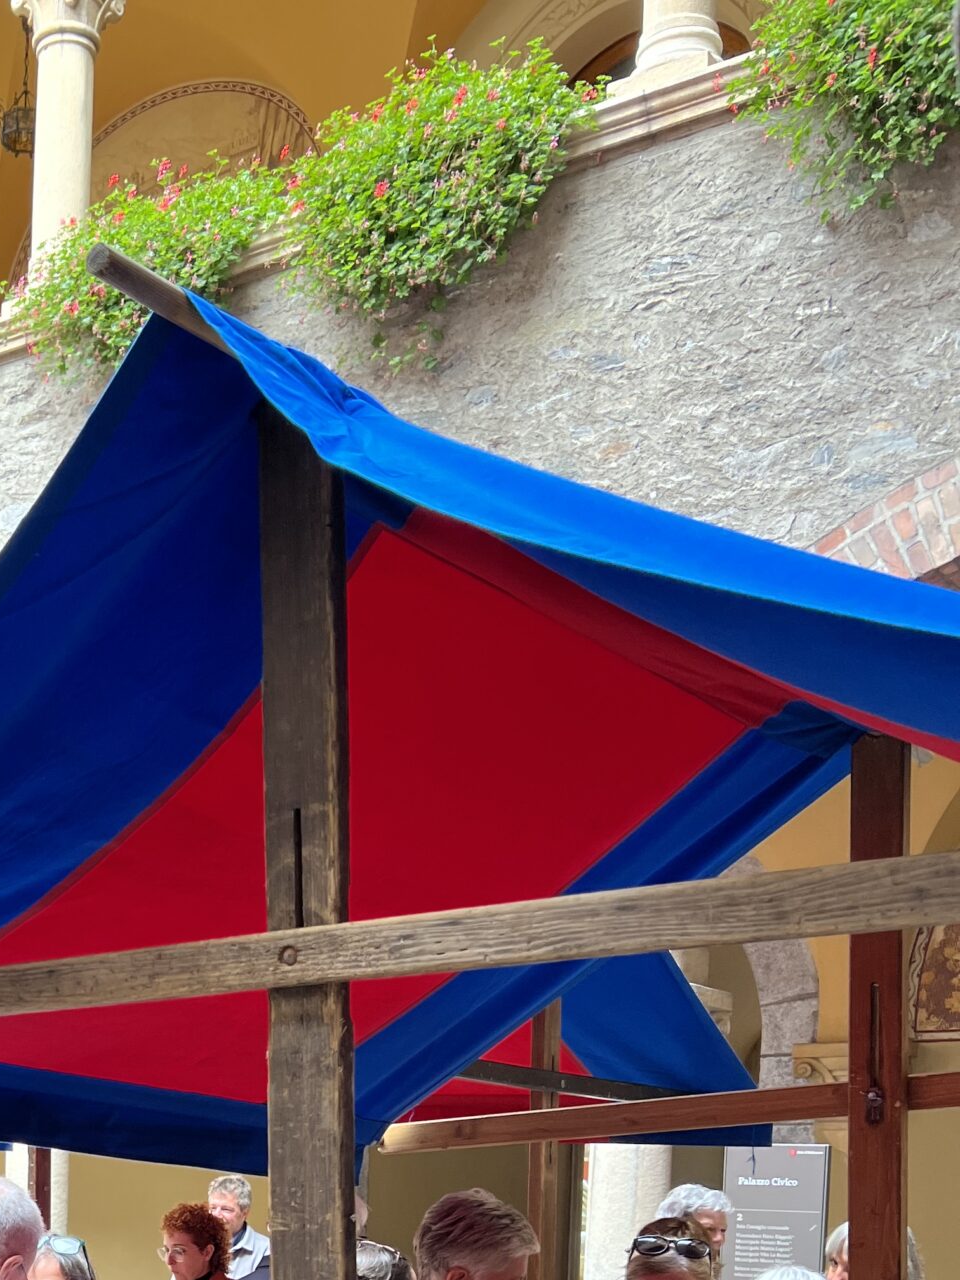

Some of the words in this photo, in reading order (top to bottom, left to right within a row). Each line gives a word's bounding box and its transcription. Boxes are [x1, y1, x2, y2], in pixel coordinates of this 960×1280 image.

[738, 1176, 770, 1186] Palazzo
[771, 1177, 798, 1187] Civico
[736, 1213, 744, 1221] 2
